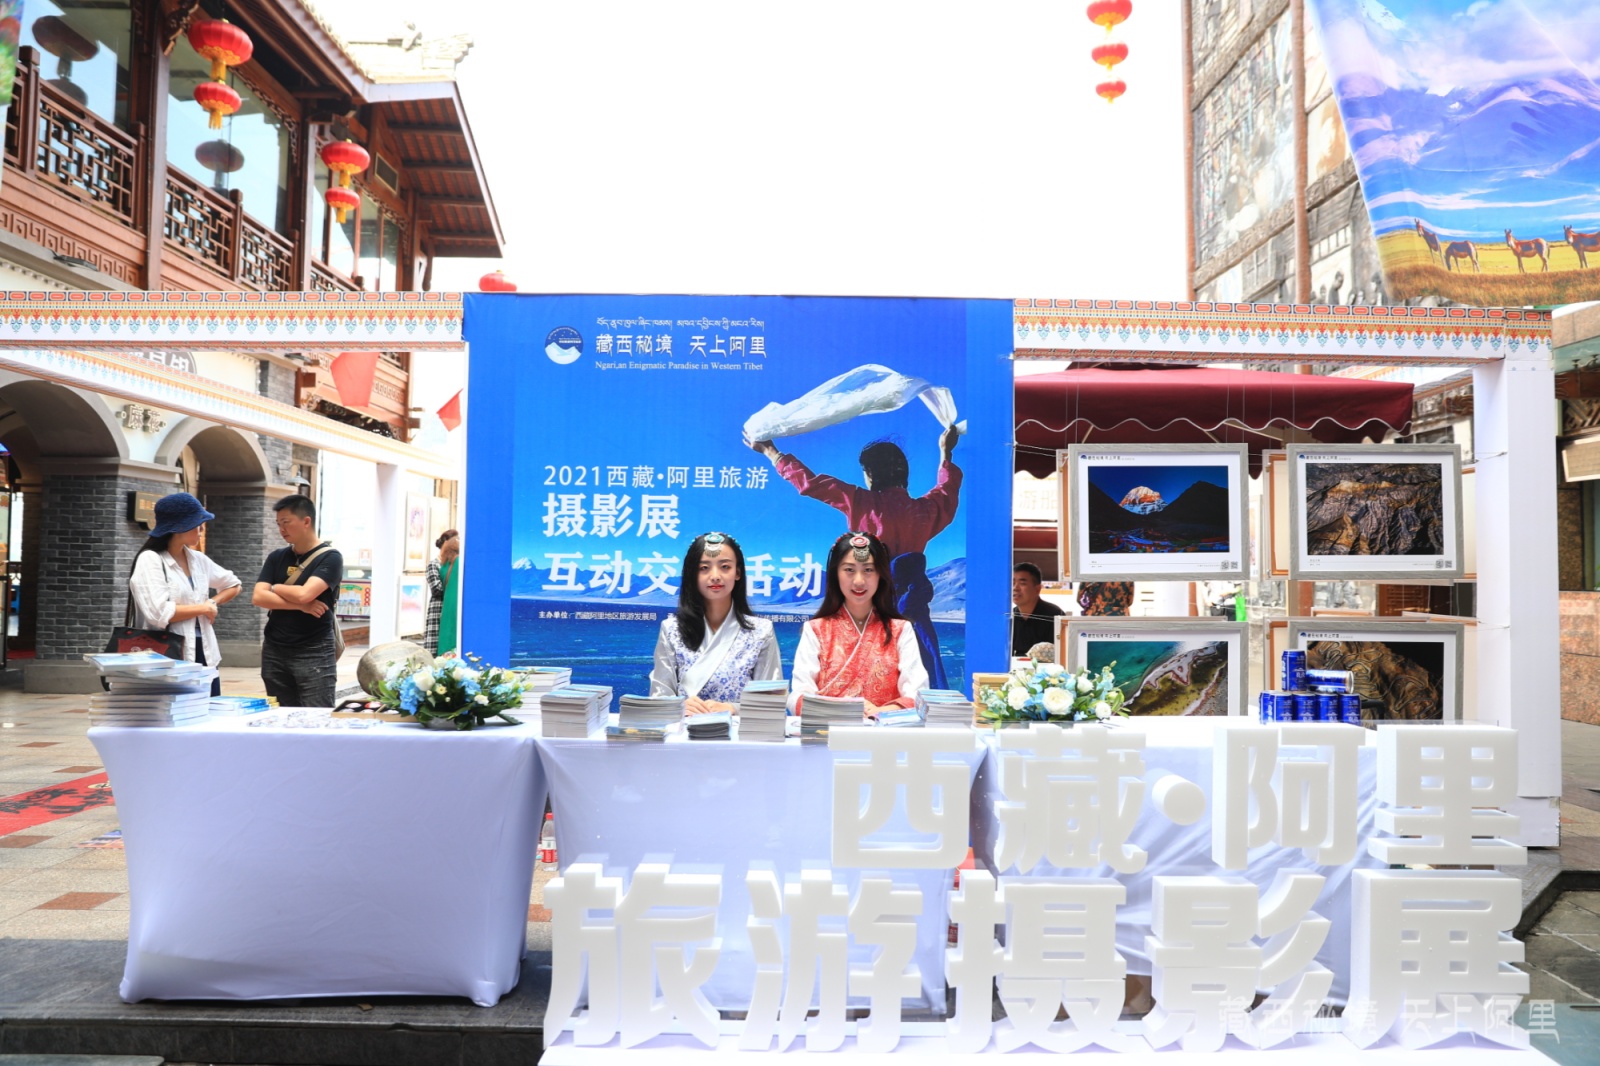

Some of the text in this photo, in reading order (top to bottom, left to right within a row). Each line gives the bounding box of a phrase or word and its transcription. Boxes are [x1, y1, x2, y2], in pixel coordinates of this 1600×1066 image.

[596, 334, 673, 357] 藏西秘境
[689, 335, 767, 358] 天上阿里
[629, 361, 667, 370] Enigmatic
[668, 361, 700, 370] Paradise
[701, 361, 709, 370] in
[711, 361, 742, 370] Western
[743, 362, 763, 371] Tibet
[543, 464, 769, 490] 2021西藏·阿里旅游
[541, 492, 681, 539] 摄影展
[541, 550, 824, 598] 互动交活动
[542, 861, 1530, 1054] 旅游摄影展
